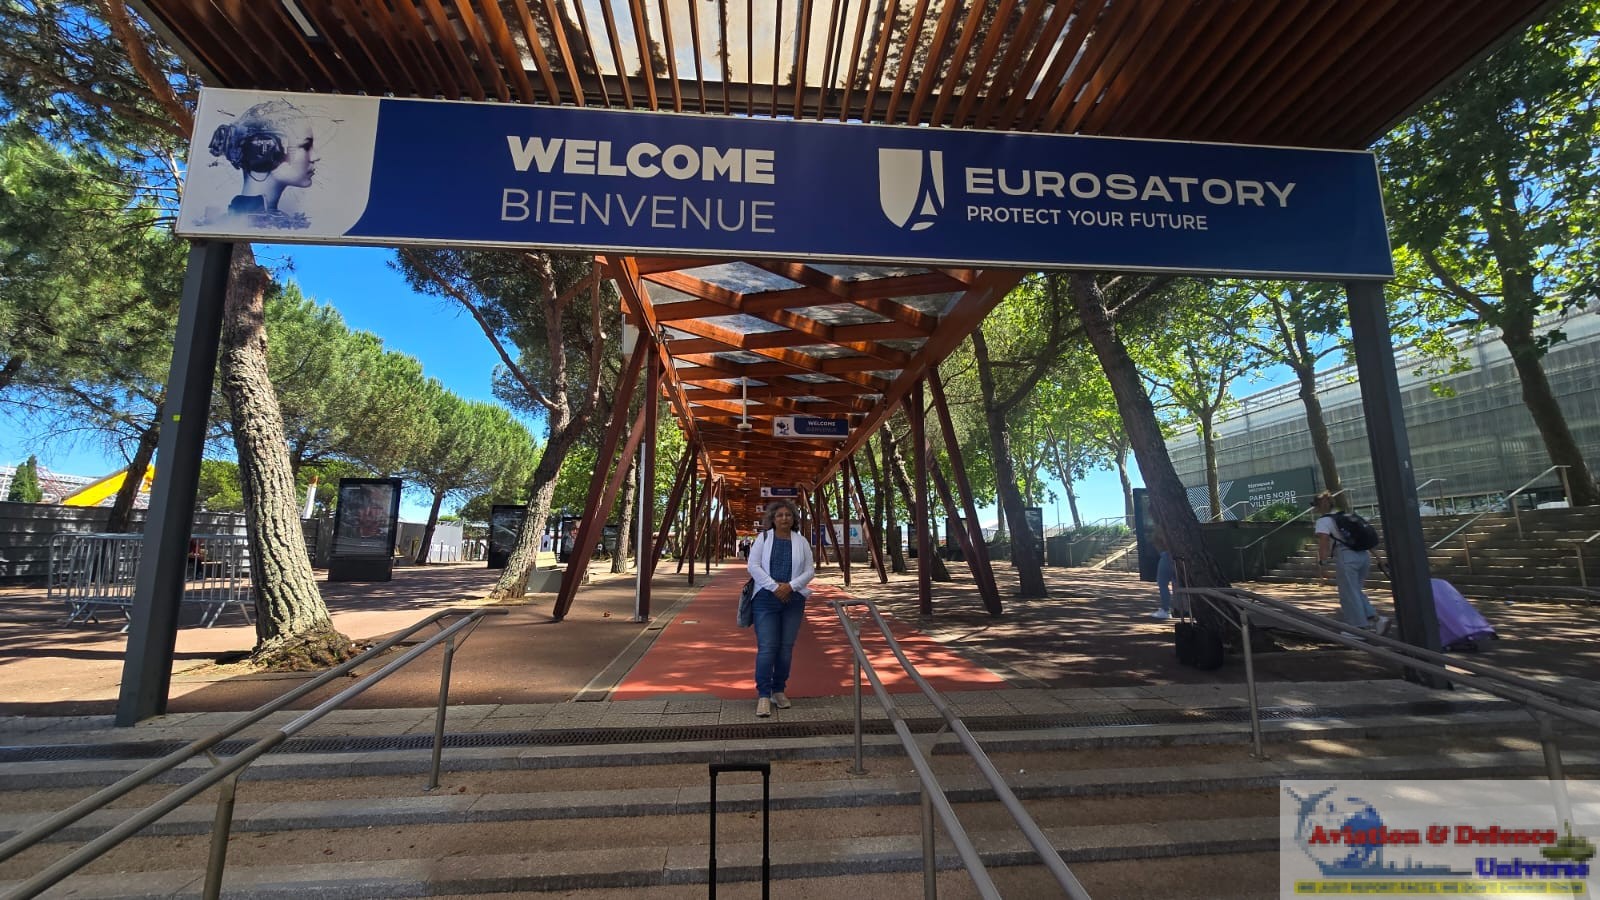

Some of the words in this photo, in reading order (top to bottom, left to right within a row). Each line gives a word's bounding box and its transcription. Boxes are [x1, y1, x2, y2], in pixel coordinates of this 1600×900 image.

[507, 135, 776, 185] WELCOME
[965, 166, 1297, 208] EUROSATORY
[500, 187, 777, 234] BIENVENUE
[966, 205, 1062, 226] PROTECT
[1067, 208, 1125, 228] YOUR
[1130, 211, 1209, 232] FUTURE
[1272, 490, 1296, 499] NORD
